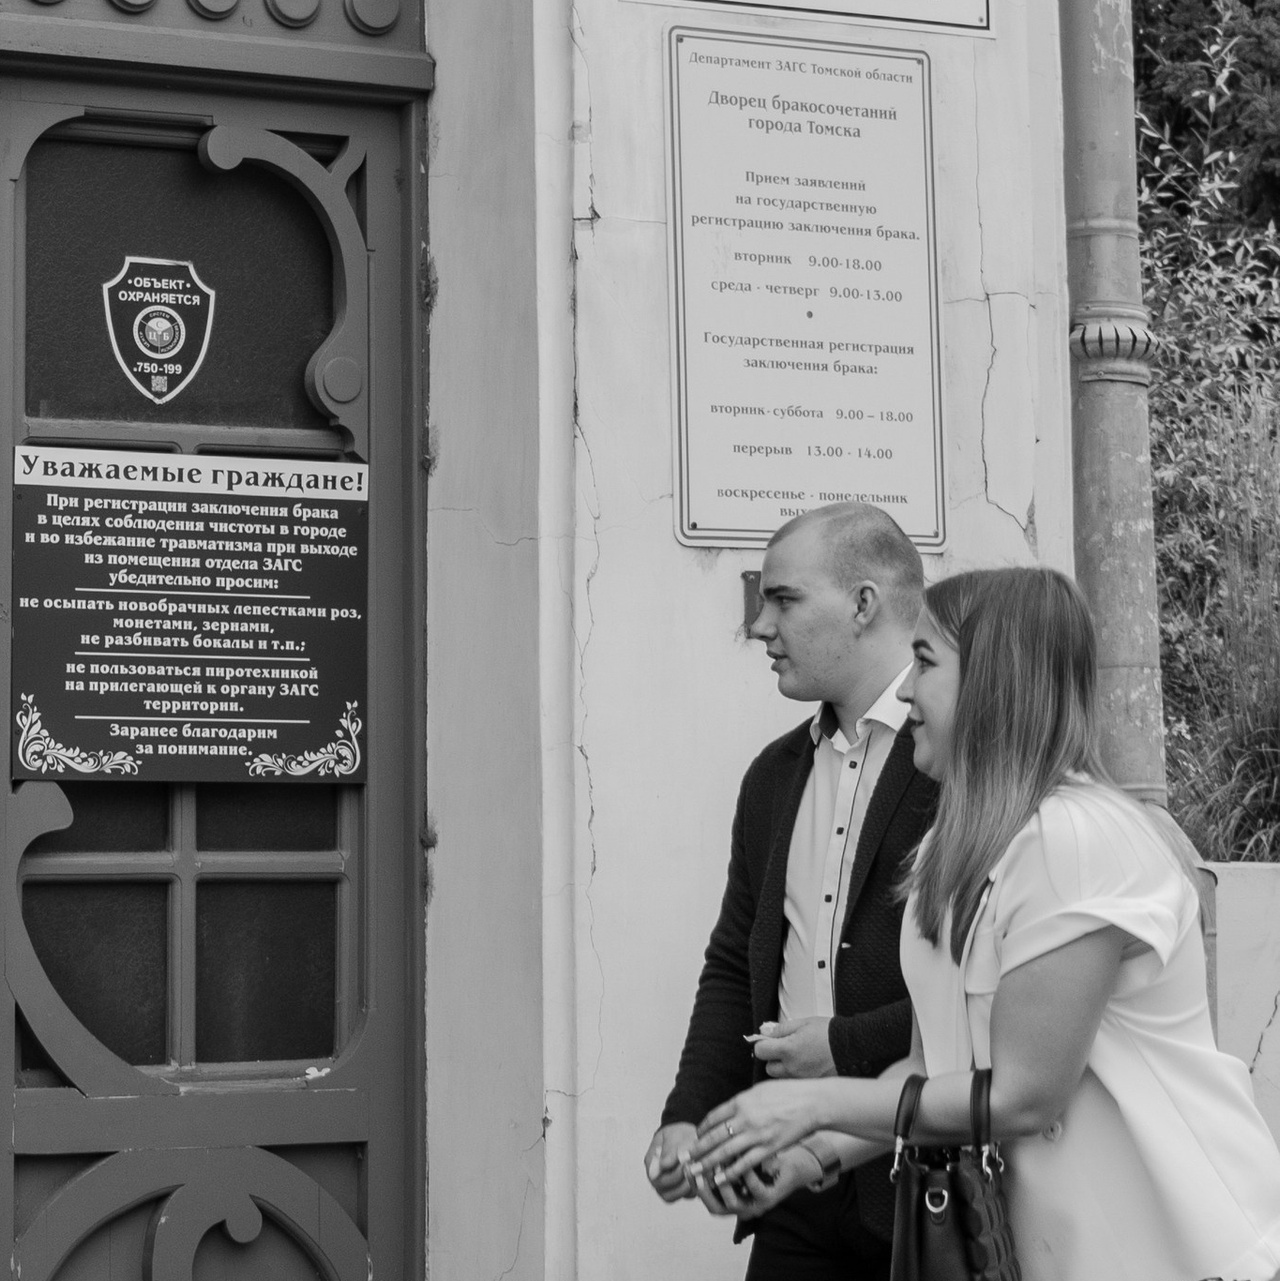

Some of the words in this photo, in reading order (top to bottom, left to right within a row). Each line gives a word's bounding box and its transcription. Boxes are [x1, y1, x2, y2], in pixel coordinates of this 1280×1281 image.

[688, 51, 772, 70] Департамент
[775, 59, 807, 74] ЗАГС
[810, 63, 862, 79] Томской
[865, 68, 913, 84] области
[708, 90, 768, 111] Дворец
[771, 94, 897, 121] бракосочетаний
[748, 117, 802, 134] города
[807, 120, 861, 138] Томска
[745, 170, 790, 186] Прием
[795, 176, 866, 192] заявлений
[735, 193, 752, 206] на
[756, 196, 877, 216] государственную
[691, 214, 784, 230] регистрацию
[789, 220, 872, 237] заключения
[876, 225, 920, 241] брака.
[734, 250, 792, 265] вторник
[133, 276, 185, 290] ОБЪЕКТ
[710, 279, 752, 293] среда
[765, 282, 820, 299] четверг
[118, 290, 201, 306] ОХРАНЯЕТСЯ
[703, 331, 824, 350] Государственная
[828, 340, 914, 357] регистрация
[744, 357, 829, 372] заключения
[833, 359, 878, 376] брака:
[835, 408, 864, 421] 9.00
[879, 411, 914, 422] 18.00
[733, 443, 793, 457] перерыв
[806, 445, 843, 458] 13.00
[857, 447, 893, 460] 14.00
[20, 454, 202, 484] Уважаемые
[211, 469, 364, 493] граждане!
[717, 486, 806, 501] воскресенье
[818, 490, 909, 504] понедельник
[46, 493, 79, 511] При
[83, 497, 187, 515] регистрации
[191, 502, 289, 517] заключения
[292, 502, 339, 521] брака
[37, 514, 48, 525] в
[51, 514, 101, 528] целях
[104, 514, 205, 533] соблюдения
[208, 521, 276, 535] чистоты
[279, 524, 290, 535] в
[293, 525, 347, 540] городе
[24, 532, 36, 543] и
[40, 532, 61, 544] во
[64, 531, 156, 548] избежание
[159, 537, 263, 553] травматизма
[266, 542, 296, 557] при
[300, 543, 358, 559] выходе
[84, 553, 104, 565] из
[107, 554, 201, 569] помещения
[204, 558, 259, 572] отдела
[262, 557, 303, 572] ЗАГС
[108, 570, 212, 587] убедительно
[215, 576, 279, 591] просим:
[19, 597, 40, 608] не
[43, 598, 115, 611] осыпать
[118, 598, 230, 616] новобрачных
[233, 604, 327, 618] лепестками
[330, 608, 362, 621] роз,
[112, 618, 198, 632] монетами,
[202, 620, 275, 635] зернами,
[80, 634, 101, 645] не
[104, 632, 190, 649] разбивать
[192, 633, 254, 650] бокалы
[258, 639, 268, 650] и
[65, 663, 86, 674] не
[89, 663, 202, 677] пользоваться
[205, 666, 318, 681] пиротехникой
[64, 680, 85, 691] на
[88, 680, 203, 696] прилегающей
[206, 683, 217, 695] к
[220, 684, 276, 699] органу
[279, 683, 319, 697] ЗАГС
[143, 699, 244, 715] территории.
[109, 723, 178, 740] Заранее
[181, 723, 278, 742] благодарим
[135, 743, 154, 755] за
[157, 744, 253, 756] понимание.
